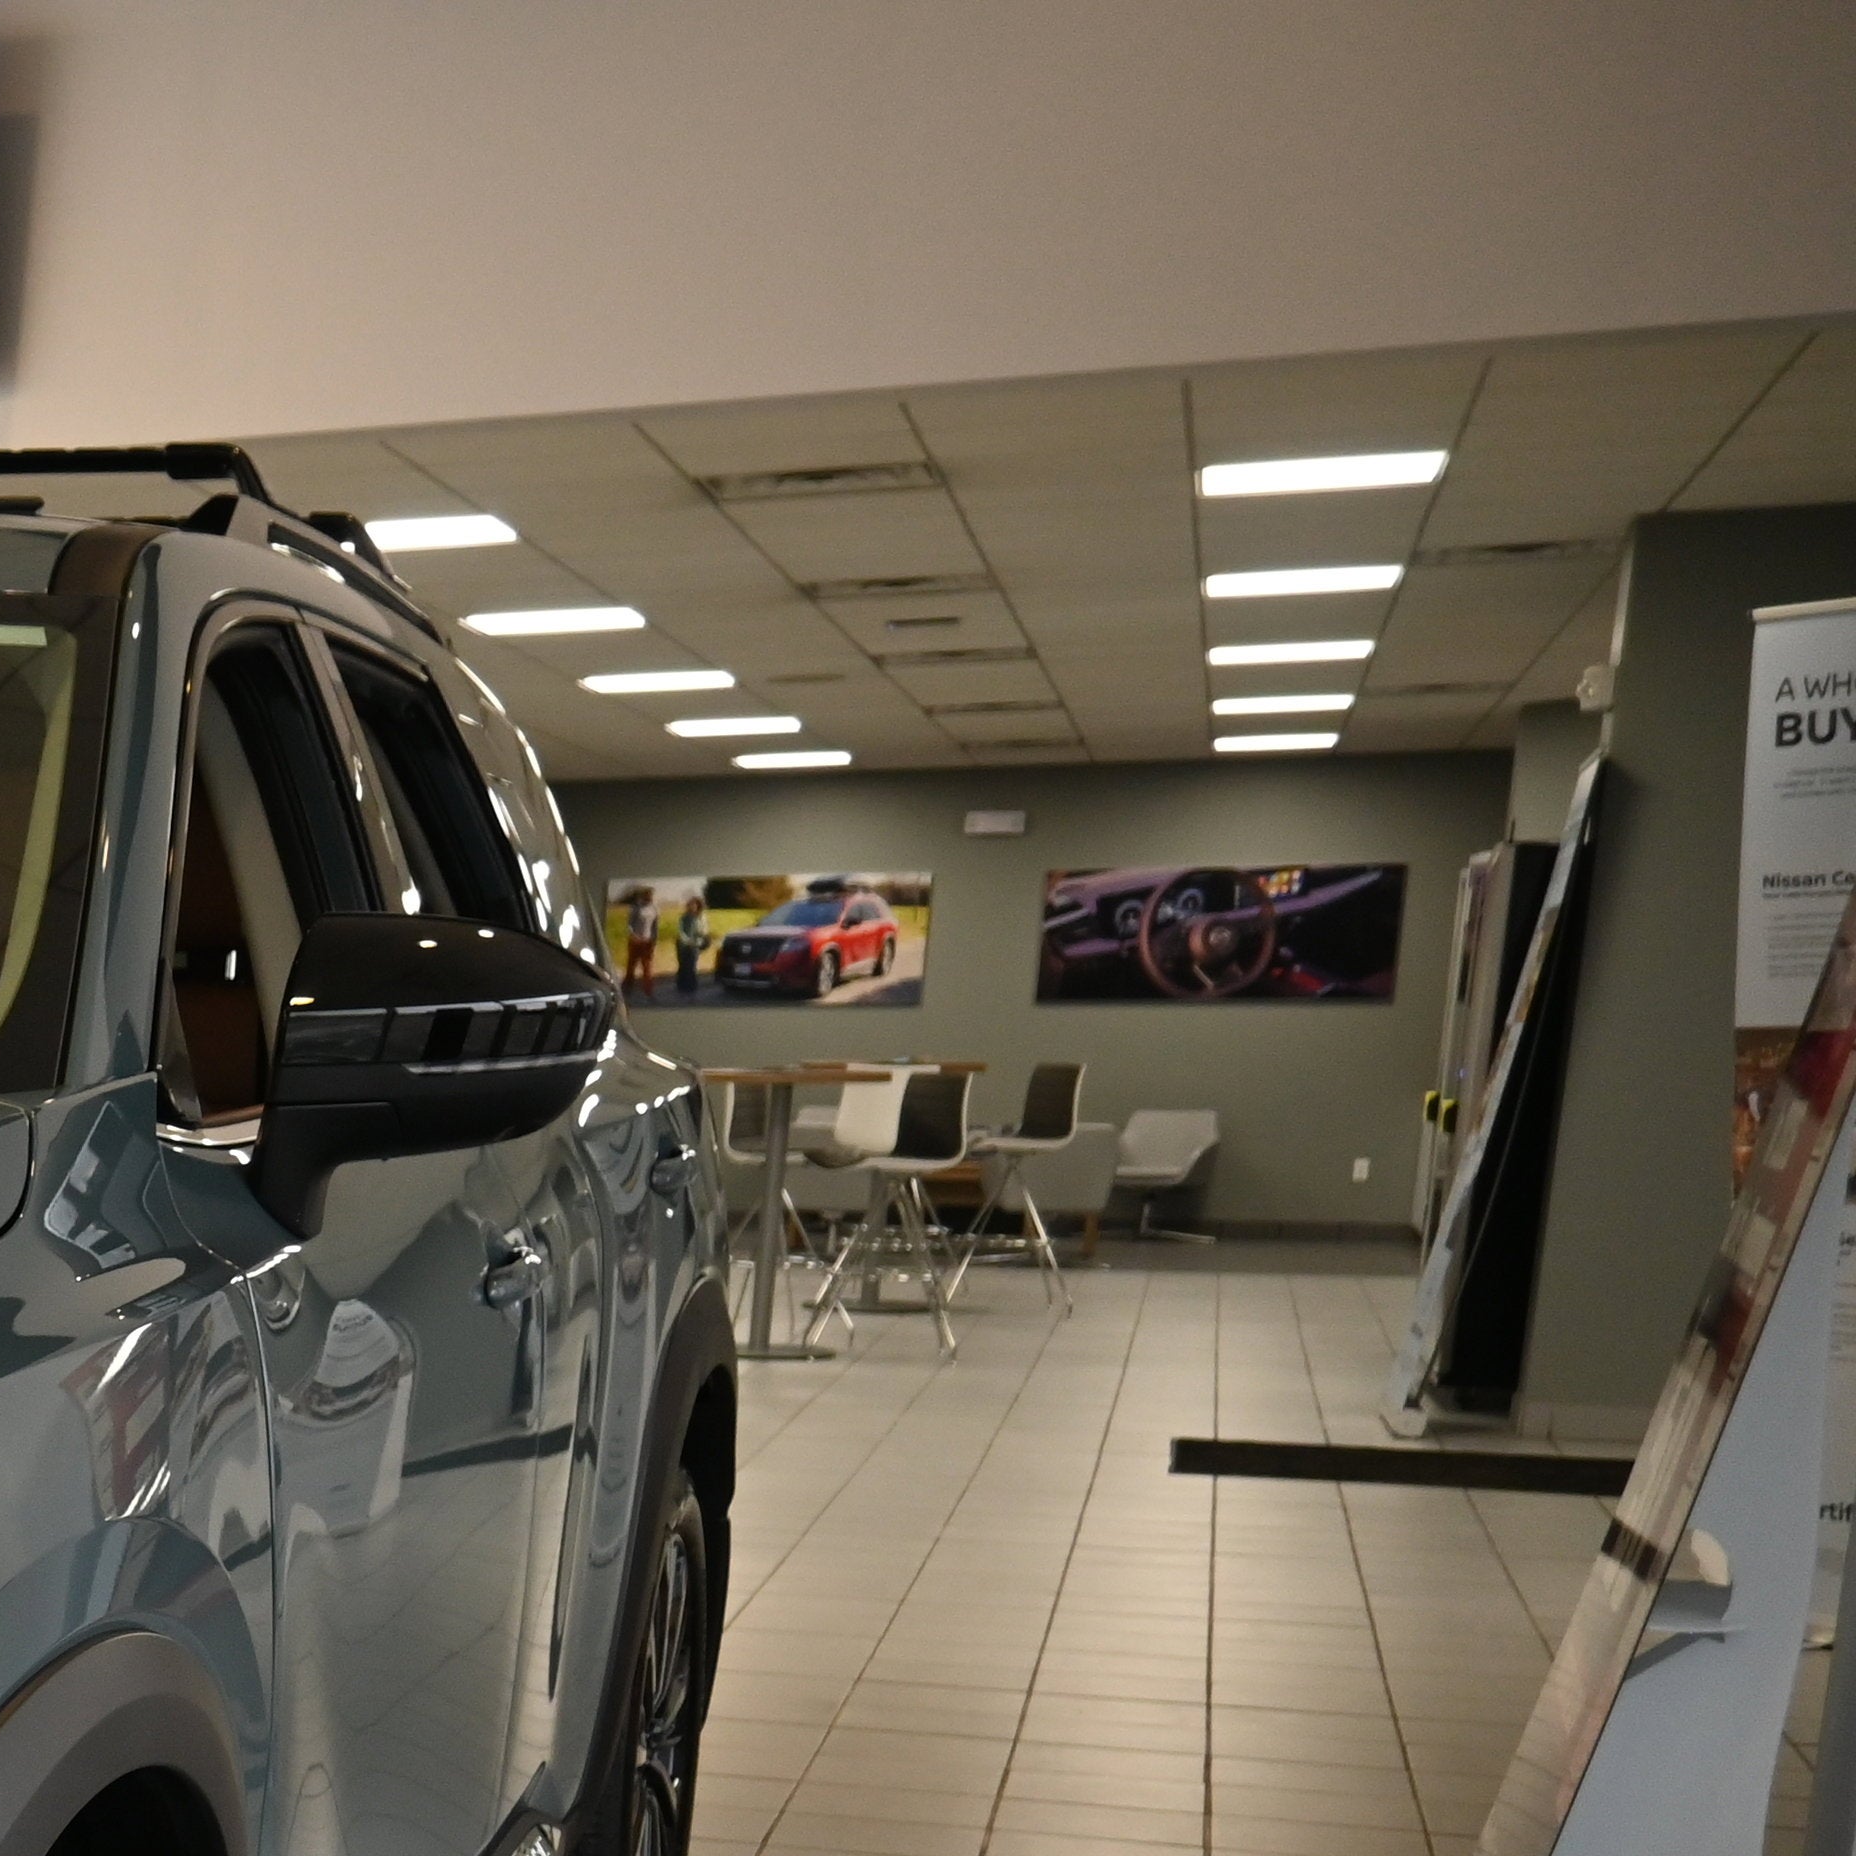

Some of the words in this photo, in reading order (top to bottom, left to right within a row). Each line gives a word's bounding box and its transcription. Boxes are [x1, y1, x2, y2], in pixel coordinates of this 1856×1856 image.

[1775, 676, 1795, 702] A
[1804, 672, 1856, 698] WH
[1762, 872, 1826, 889] Nissan
